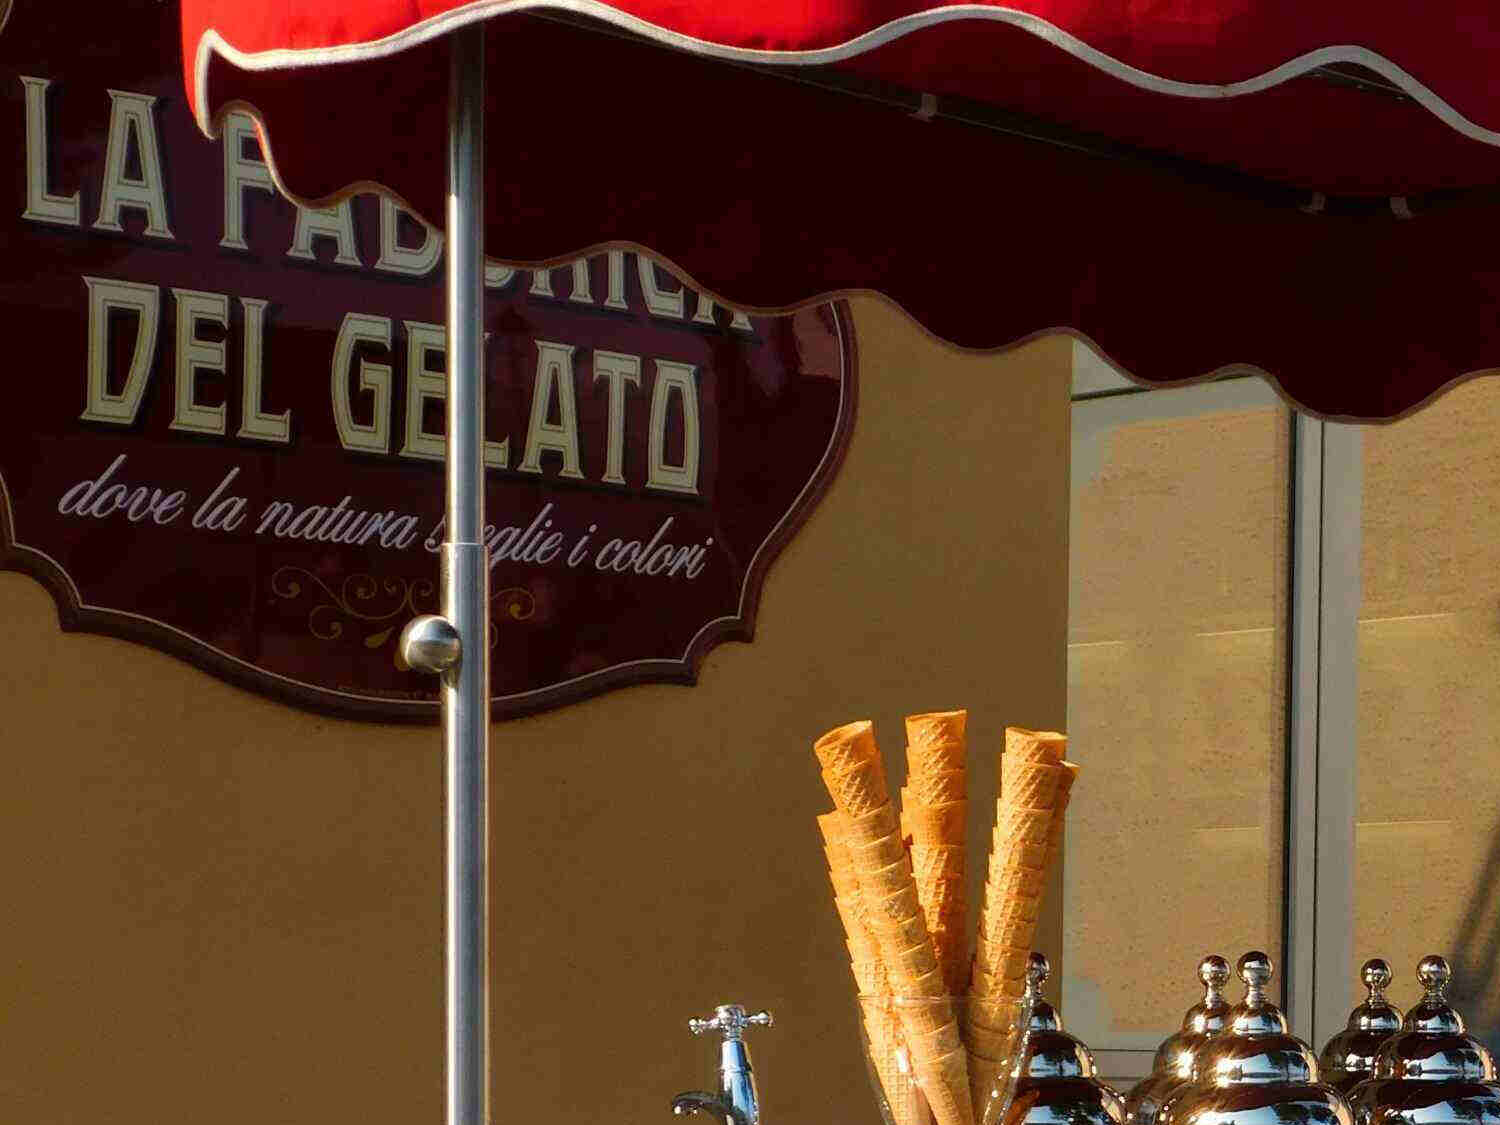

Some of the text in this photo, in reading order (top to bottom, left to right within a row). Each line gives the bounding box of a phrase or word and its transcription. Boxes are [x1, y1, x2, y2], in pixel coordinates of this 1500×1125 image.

[20, 75, 175, 240] LA
[79, 275, 700, 496] DEL GEATO
[57, 454, 188, 525] dove
[192, 467, 248, 531] la
[255, 496, 419, 549] natura
[568, 524, 597, 567] i
[595, 516, 714, 578] colori
